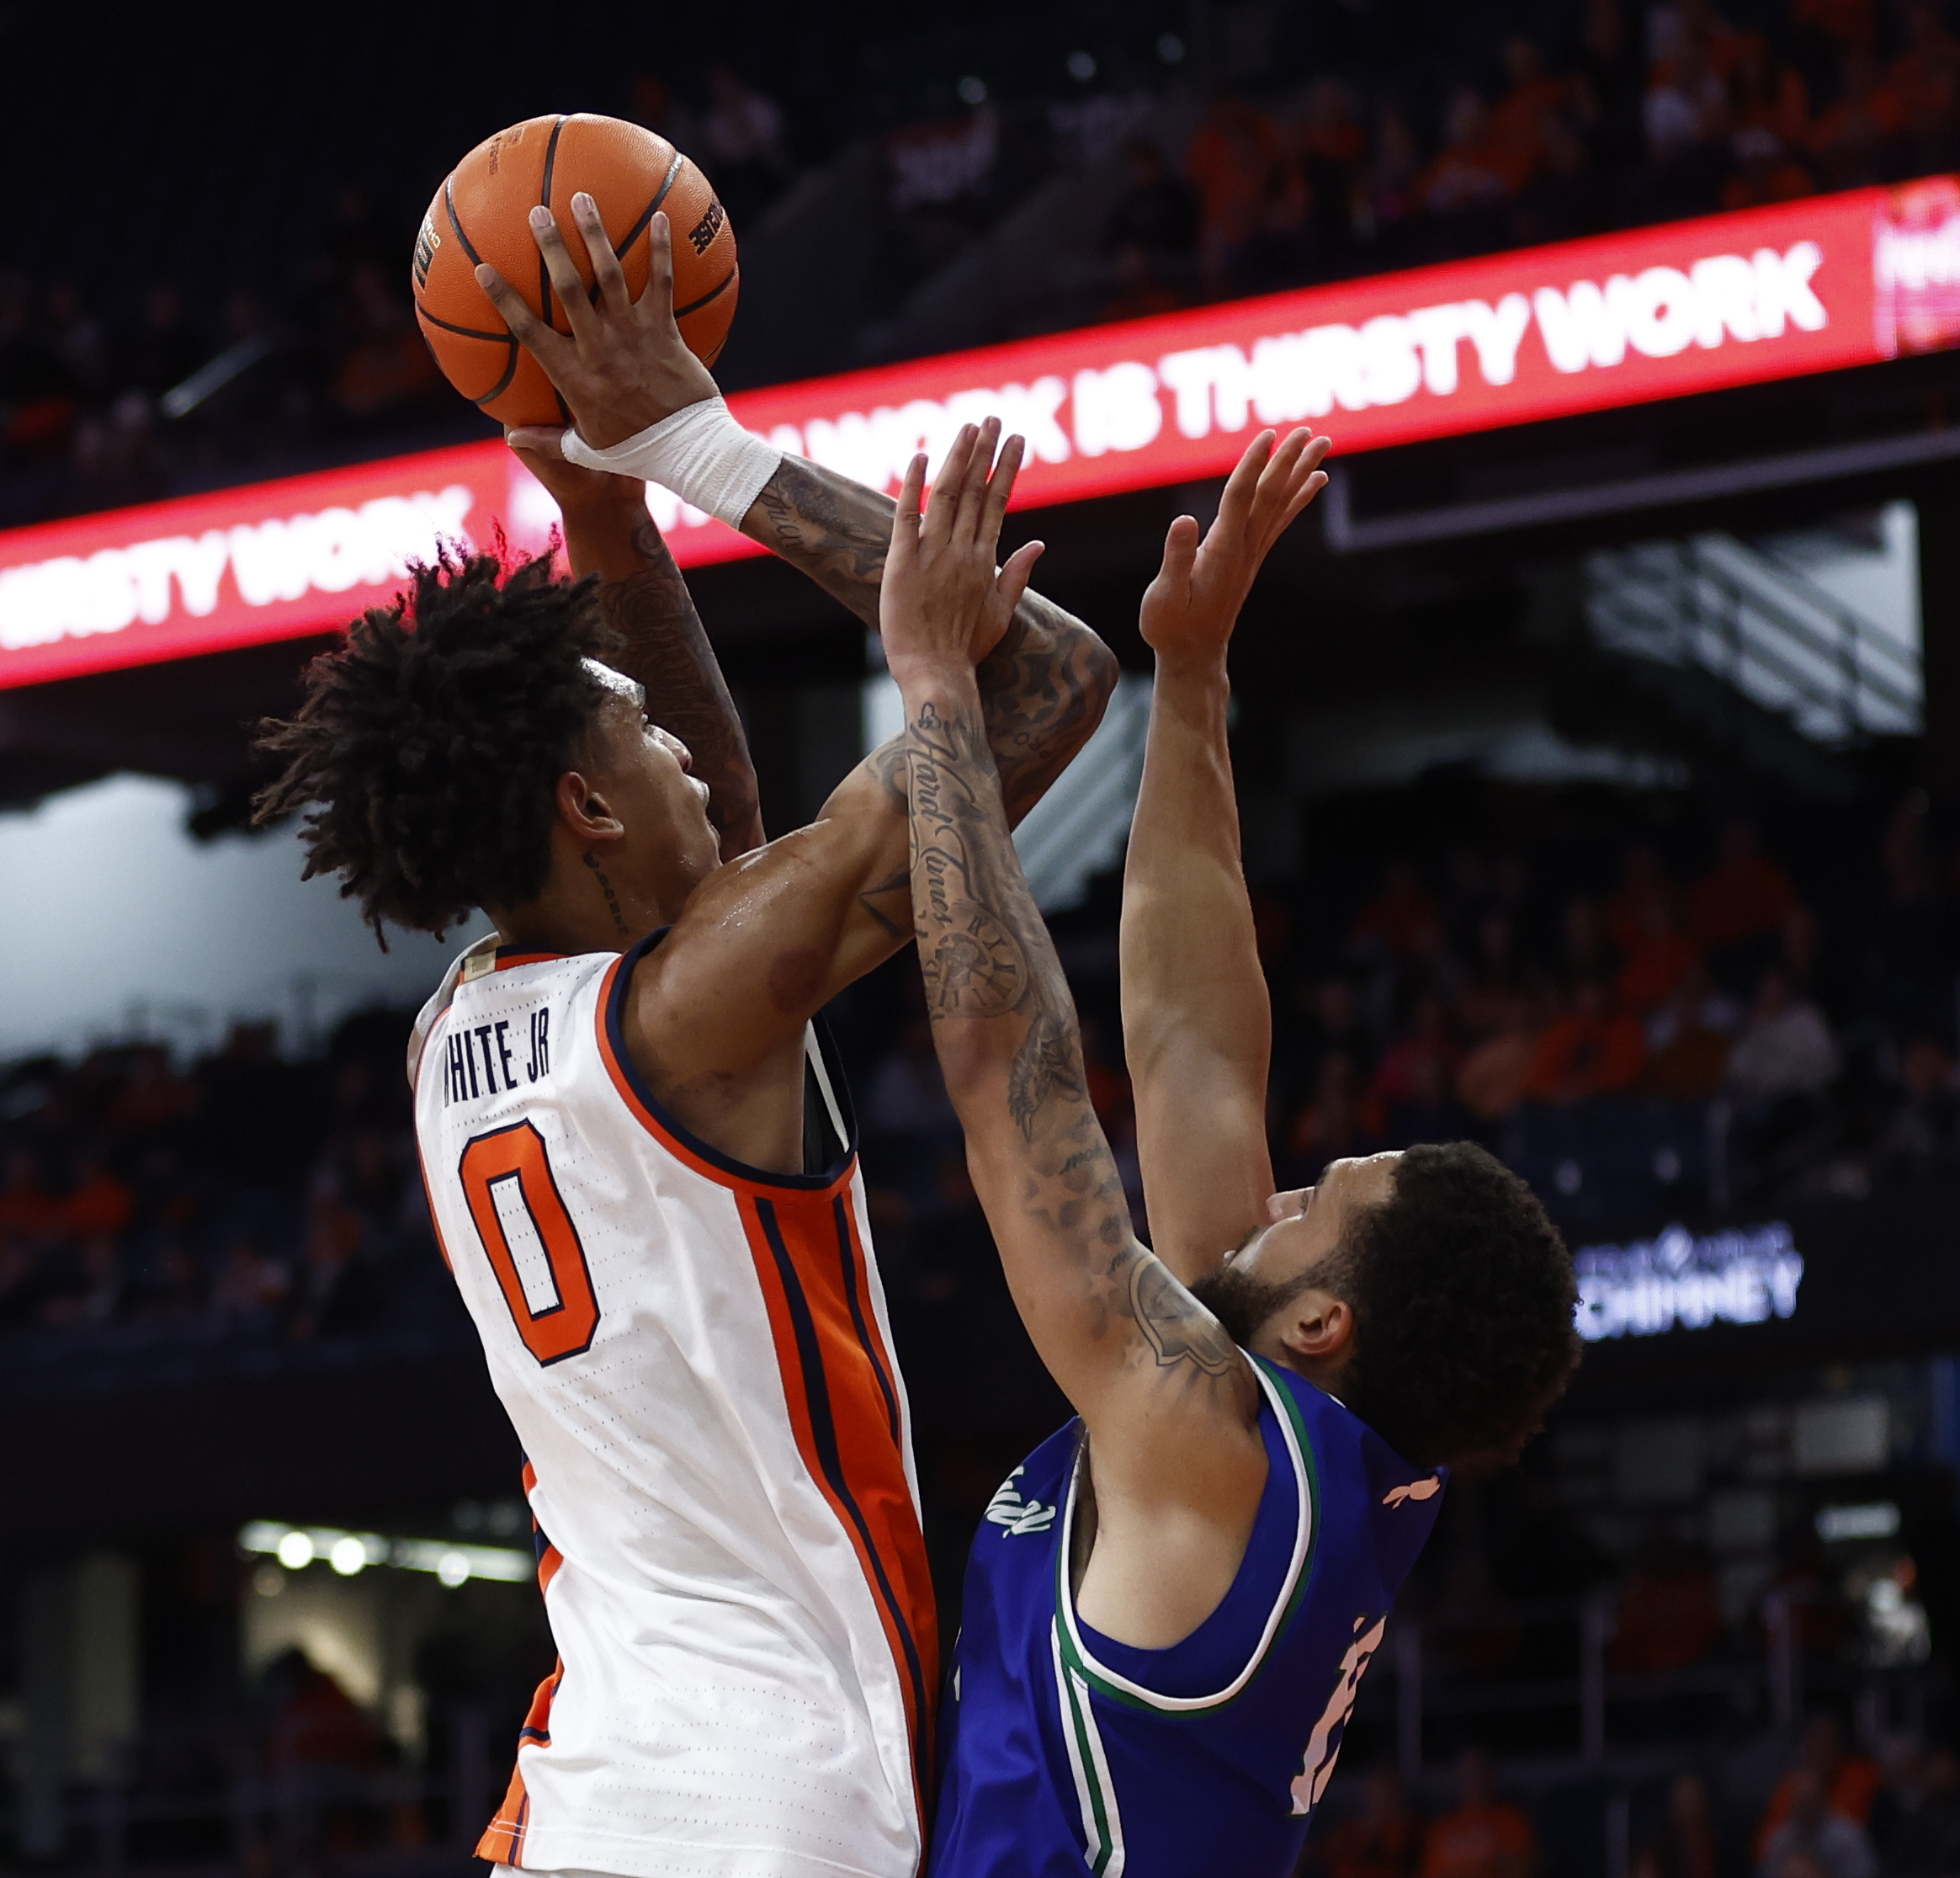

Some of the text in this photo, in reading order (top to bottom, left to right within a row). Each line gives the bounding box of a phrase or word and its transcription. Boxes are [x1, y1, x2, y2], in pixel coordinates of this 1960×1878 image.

[1073, 362, 1162, 464] IS
[1162, 293, 1530, 438] THIRSTY
[1533, 241, 1827, 373] WORK
[227, 491, 473, 604] WORK
[444, 1007, 549, 1107] HITE JR
[459, 1118, 601, 1368] 0
